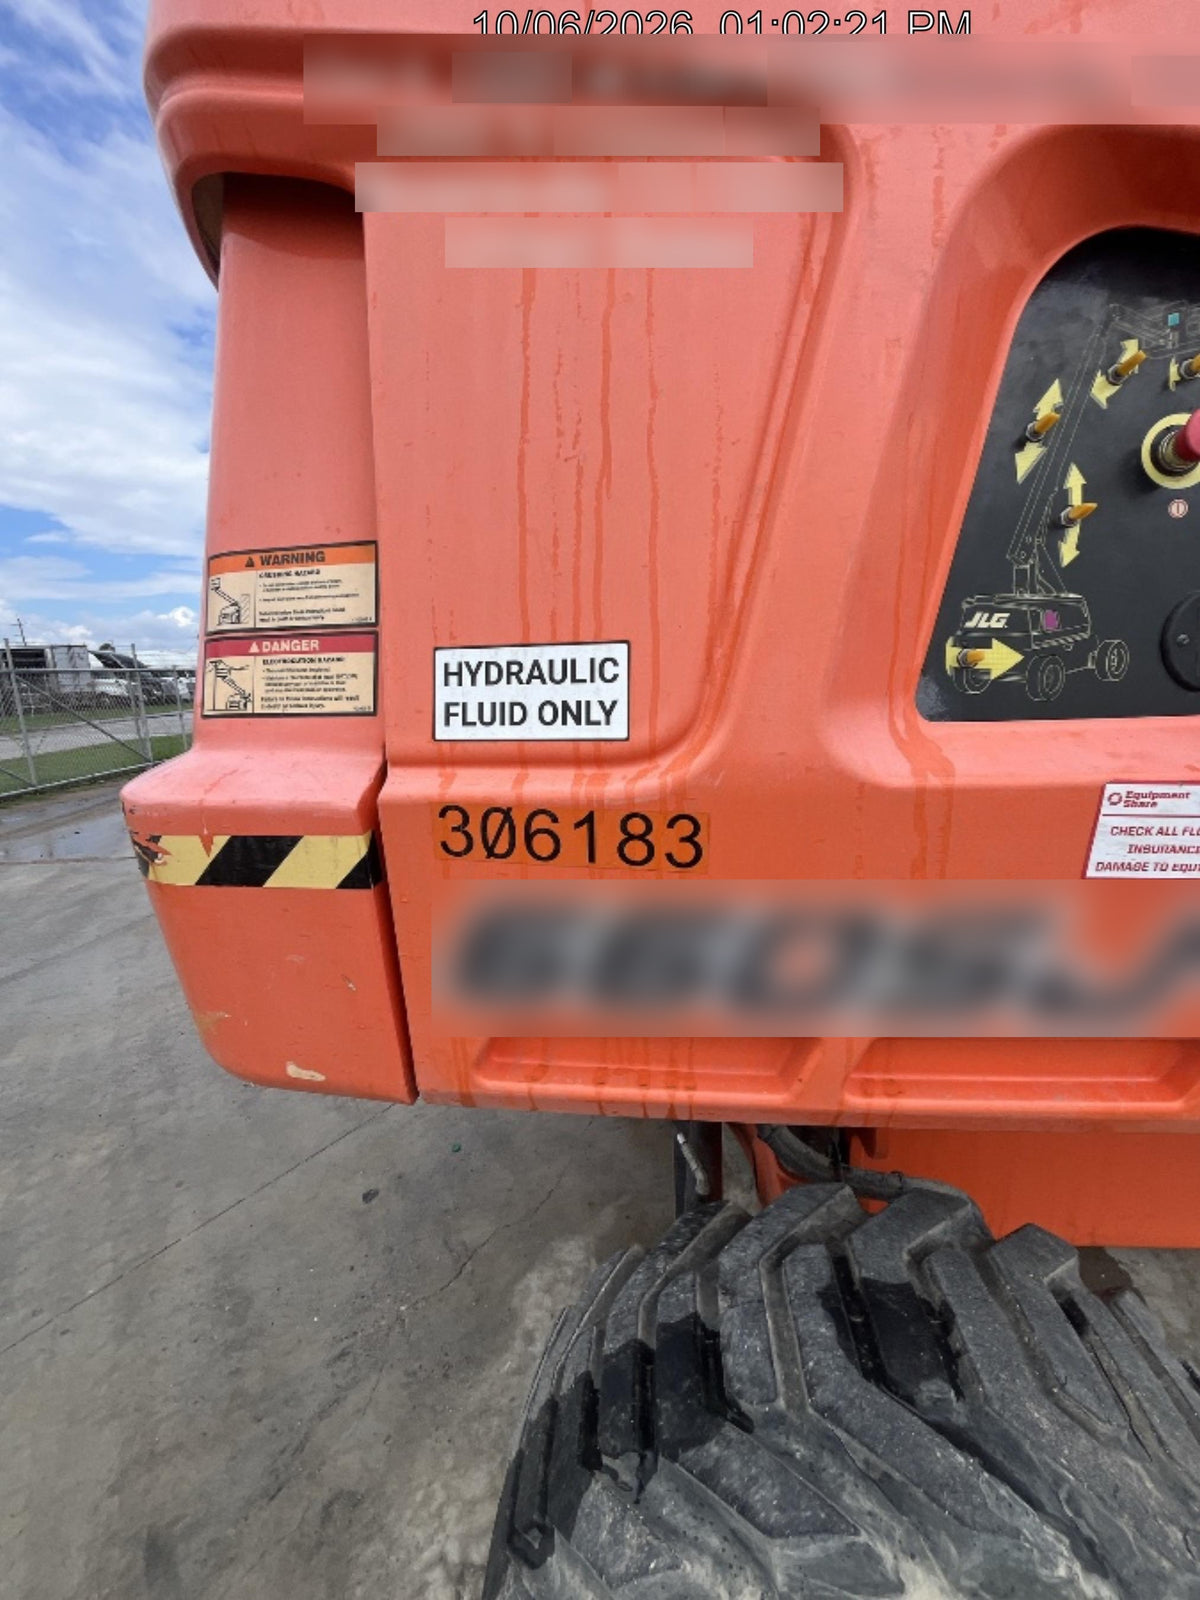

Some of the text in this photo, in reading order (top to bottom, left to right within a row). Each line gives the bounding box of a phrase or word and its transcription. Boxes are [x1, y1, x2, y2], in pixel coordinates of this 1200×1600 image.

[260, 551, 325, 567] WARNING
[964, 612, 1010, 629] JLG
[262, 640, 320, 652] DANGER
[443, 657, 620, 687] HYDRAULIC
[444, 699, 618, 727] FLUID ONLY
[1125, 791, 1191, 801] Equipment
[1123, 800, 1158, 808] Share
[438, 805, 703, 869] 306183
[1110, 826, 1154, 836] CHECK
[1155, 826, 1178, 836] ALL
[1095, 861, 1149, 872] DAMAGE
[1153, 862, 1169, 872] TO
